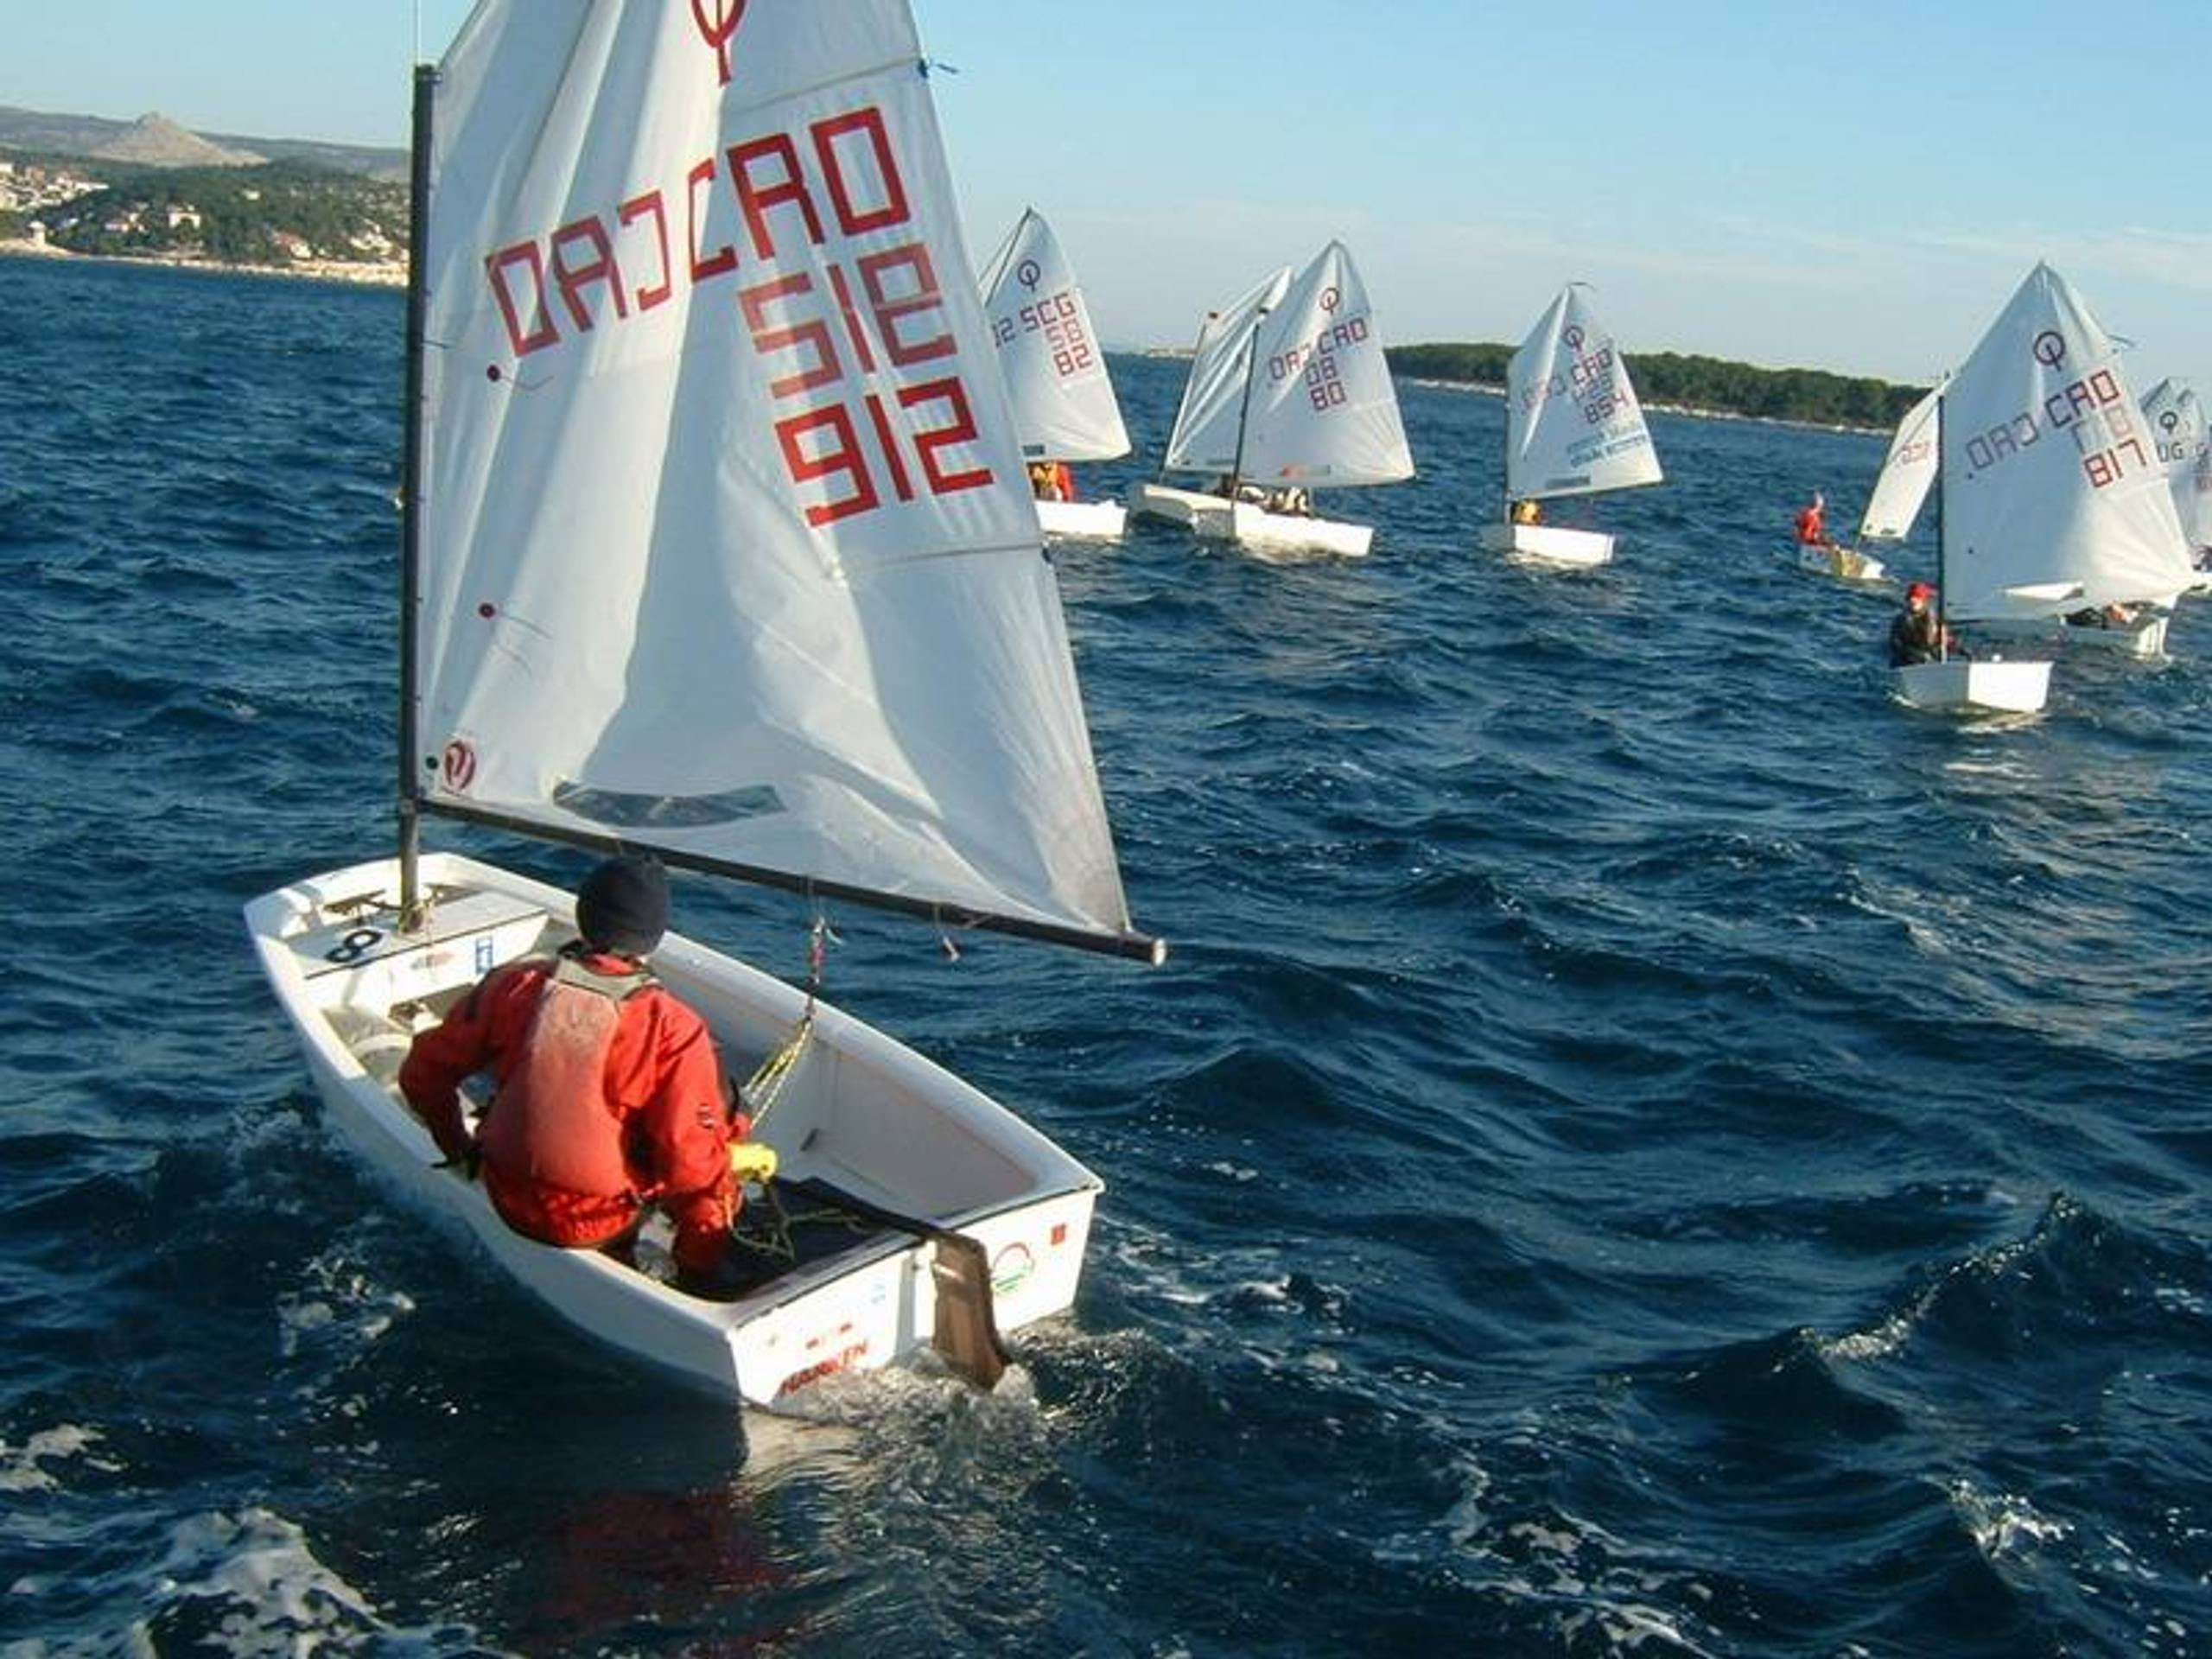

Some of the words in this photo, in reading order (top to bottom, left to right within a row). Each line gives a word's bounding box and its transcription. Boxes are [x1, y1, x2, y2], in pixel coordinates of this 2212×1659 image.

[1020, 292, 1077, 333] SCG
[1053, 343, 1092, 376] 82
[1310, 381, 1347, 410] 80
[1585, 389, 1630, 423] 854
[774, 375, 995, 528] 912
[2083, 438, 2147, 487] 817
[324, 930, 383, 963] 8
